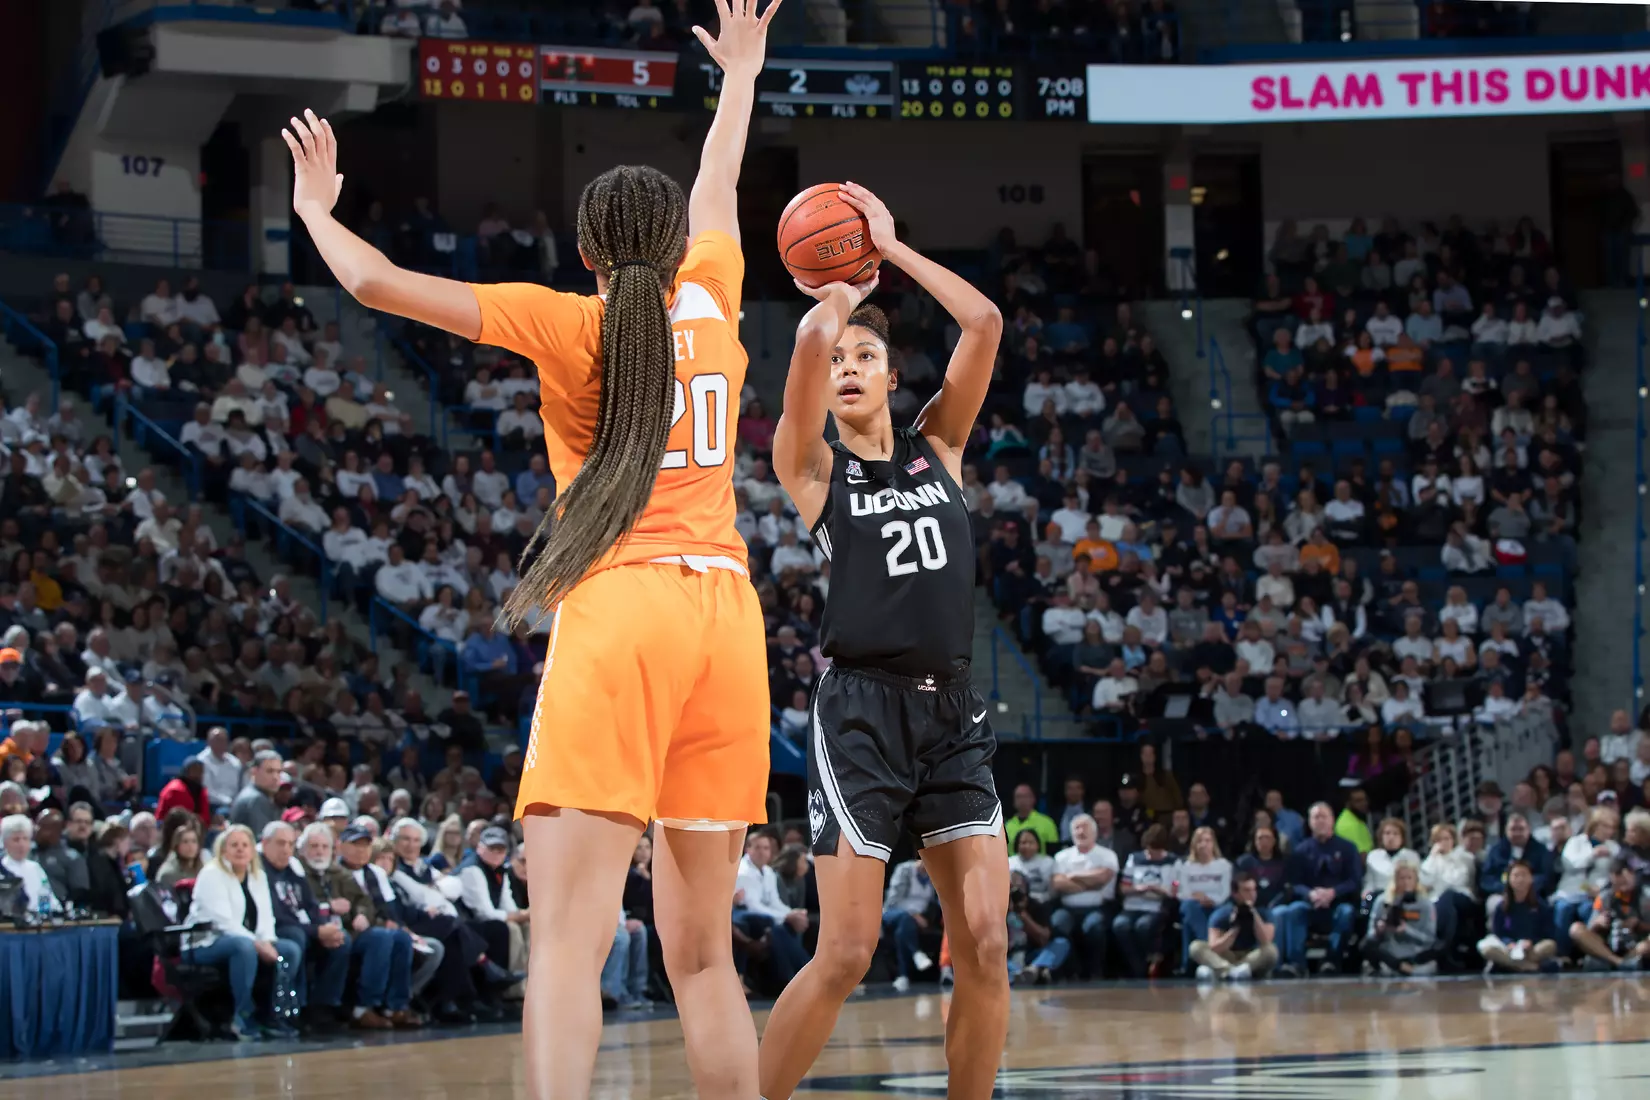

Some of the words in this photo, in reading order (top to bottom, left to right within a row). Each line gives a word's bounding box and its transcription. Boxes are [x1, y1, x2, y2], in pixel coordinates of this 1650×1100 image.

[426, 56, 440, 73] 0
[474, 58, 487, 75] 0
[496, 60, 510, 77] 0
[519, 61, 532, 78] 0
[632, 61, 650, 86] 5
[450, 79, 464, 97] 0
[476, 81, 484, 98] 1
[499, 83, 508, 99] 1
[519, 84, 533, 101] 0
[788, 69, 808, 94] 2
[929, 78, 943, 96] 0
[952, 79, 966, 96] 0
[975, 79, 989, 96] 0
[998, 79, 1011, 97] 0
[1037, 76, 1085, 97] 7:08
[1251, 73, 1384, 111] SLAM
[1397, 69, 1511, 107] THIS
[1525, 64, 1650, 101] DUNK
[900, 100, 924, 117] 20
[929, 100, 944, 117] 0
[952, 100, 966, 118] 0
[975, 101, 989, 118] 0
[998, 101, 1012, 118] 0
[1045, 99, 1076, 117] PM
[121, 156, 166, 177] 107
[816, 231, 865, 261] ELITE
[674, 330, 695, 361] EY
[849, 481, 951, 516] UCONN
[880, 516, 948, 577] 20
[918, 684, 937, 692] UCONN
